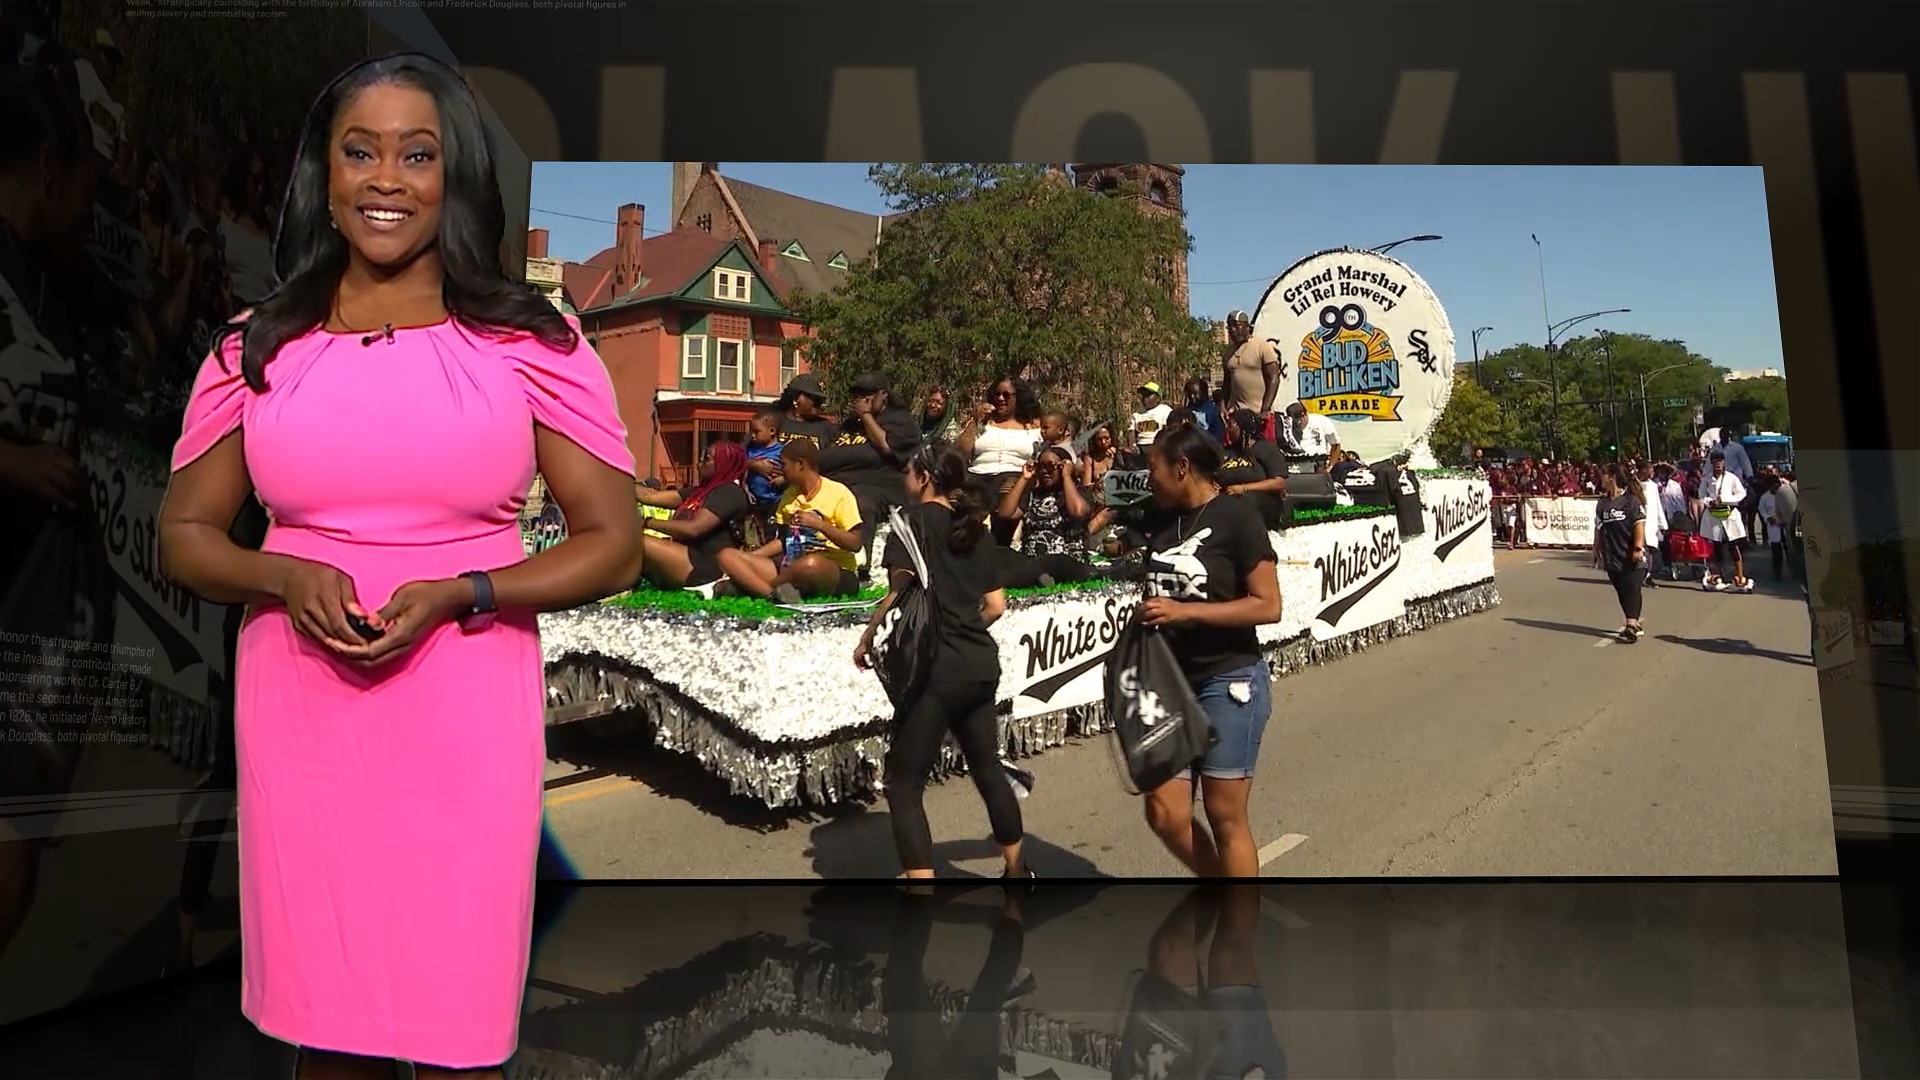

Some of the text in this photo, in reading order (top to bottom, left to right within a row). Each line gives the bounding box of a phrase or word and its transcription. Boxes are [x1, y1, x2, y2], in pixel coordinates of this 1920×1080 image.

[1283, 265, 1407, 303] Grand Marshal
[1290, 281, 1397, 317] Lil Rel Howery
[1319, 304, 1364, 342] 90
[1322, 340, 1367, 368] BUD
[1319, 399, 1380, 411] PARADE
[1110, 473, 1152, 491] Whi
[1432, 484, 1488, 541] White Sox
[1550, 514, 1590, 523] UChicago
[1550, 523, 1590, 531] Medicine
[1314, 524, 1401, 602] White Sox
[1019, 617, 1097, 678] White
